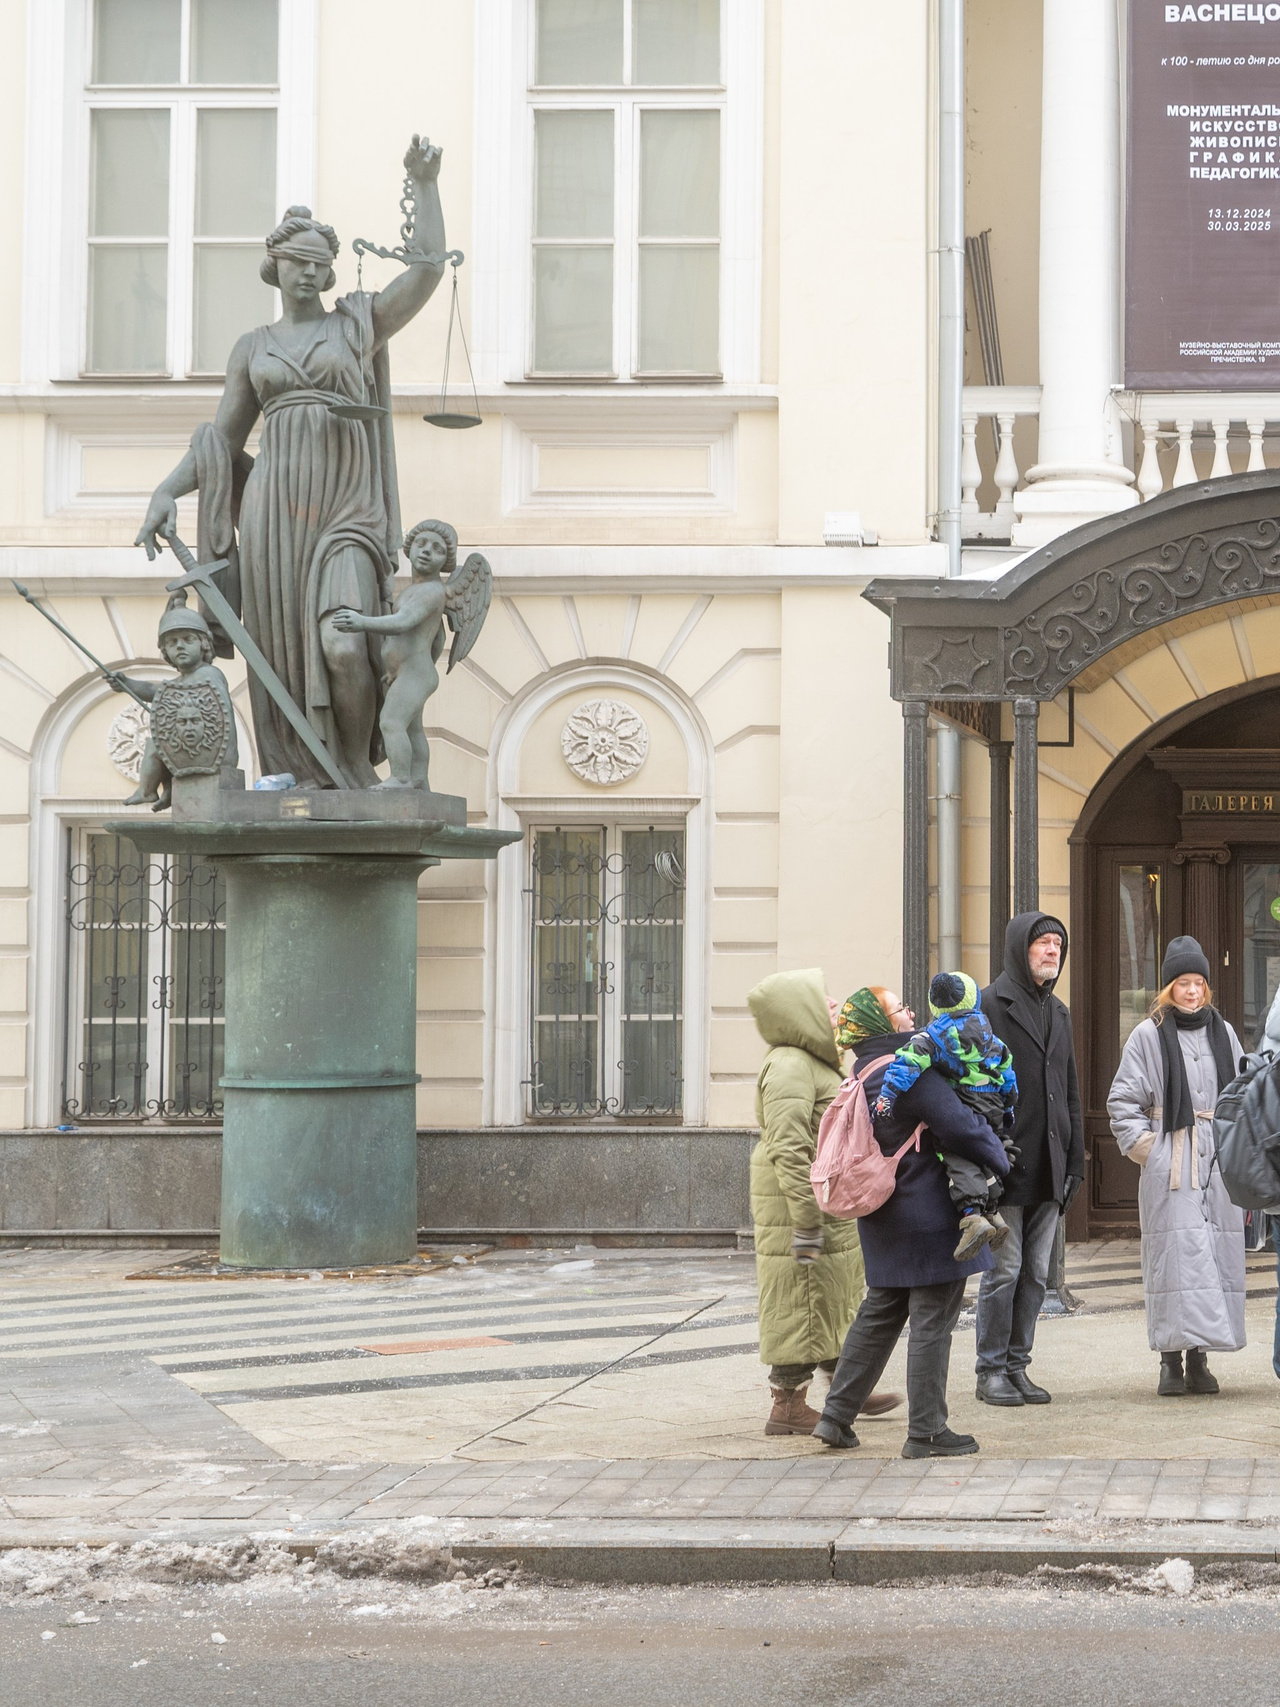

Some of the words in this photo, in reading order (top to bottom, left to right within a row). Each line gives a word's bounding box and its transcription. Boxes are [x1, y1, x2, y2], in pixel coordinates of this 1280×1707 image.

[1161, 58, 1168, 66] к
[1170, 56, 1188, 66] 100
[1196, 56, 1231, 66] летию
[1234, 57, 1246, 66] со
[1248, 55, 1265, 67] дня
[1208, 208, 1271, 219] 13.12.2024
[1207, 221, 1271, 232] 30.03.2025
[1180, 341, 1261, 349] МУЗЕЙНО-ВЫСТАВОЧНЫЙ
[1180, 348, 1222, 356] РОССИЙСКОЙ
[1210, 356, 1257, 364] ПРЕЧИСТЕНКА,
[1189, 795, 1275, 812] ГАЛЕРЕЯ
